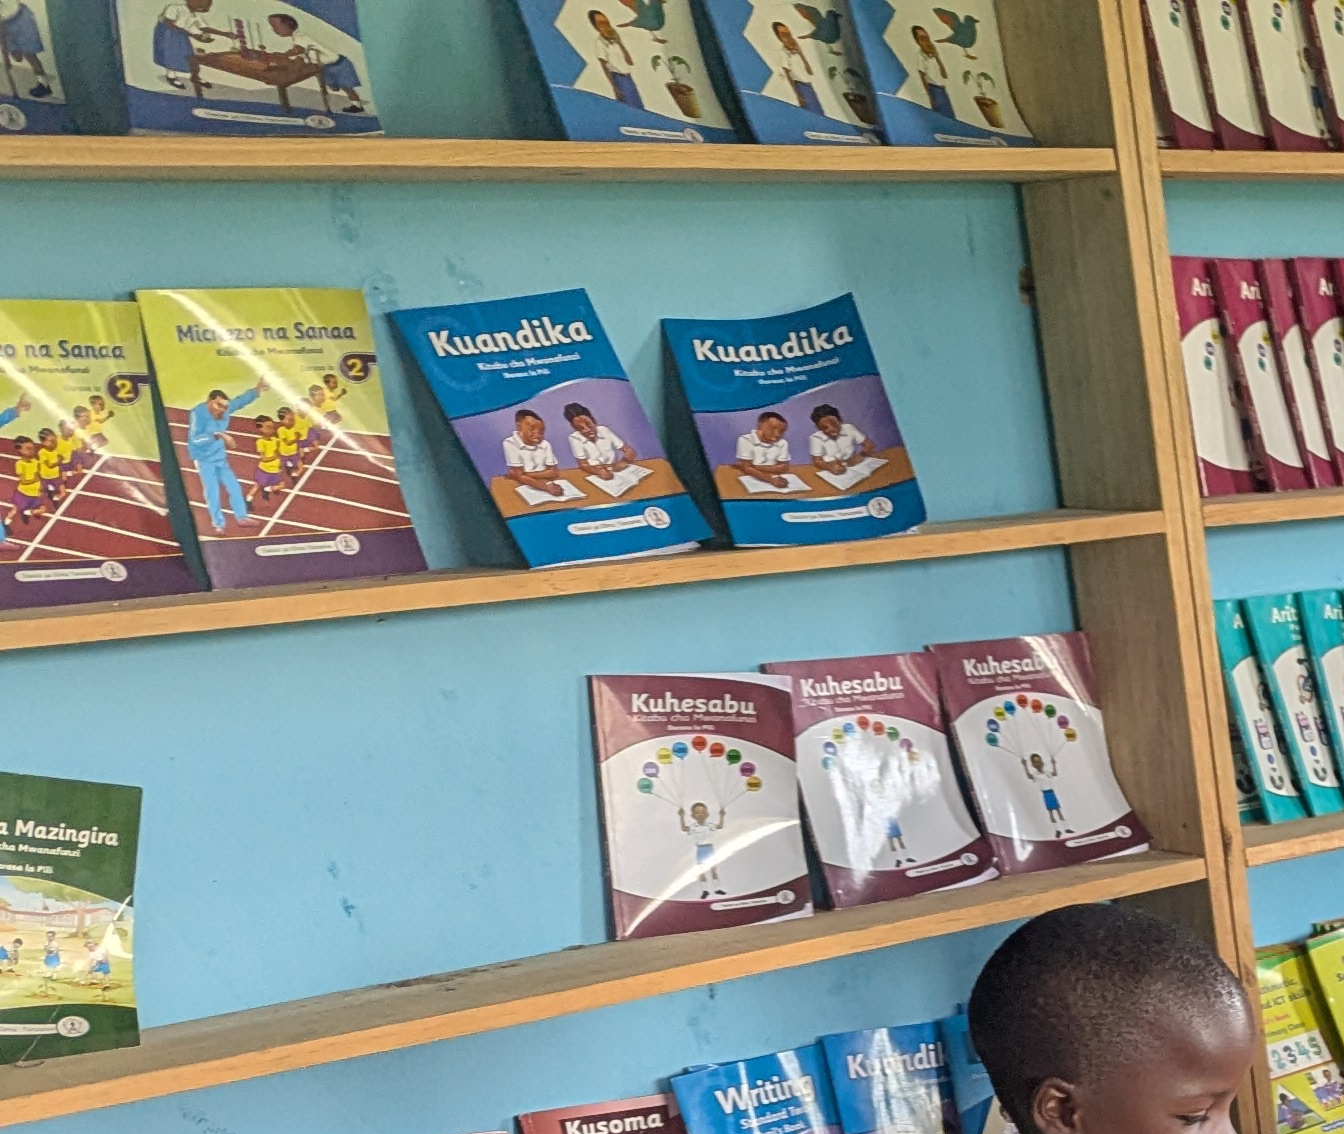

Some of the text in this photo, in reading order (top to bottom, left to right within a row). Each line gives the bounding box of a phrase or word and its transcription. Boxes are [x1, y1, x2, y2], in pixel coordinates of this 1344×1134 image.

[263, 326, 289, 340] na
[295, 321, 357, 340] Sanaa
[428, 316, 594, 357] Kuandika
[25, 344, 52, 359] na
[58, 340, 126, 359] Sanaa
[692, 325, 854, 363] Kuandika
[347, 358, 363, 377] 2
[115, 382, 132, 400] 2
[962, 654, 1055, 678] Kuhesab
[800, 672, 904, 698] Kuhesabu
[631, 691, 758, 716] Kuhesabu
[14, 819, 120, 848] Mazingira
[714, 1075, 816, 1115] Writing
